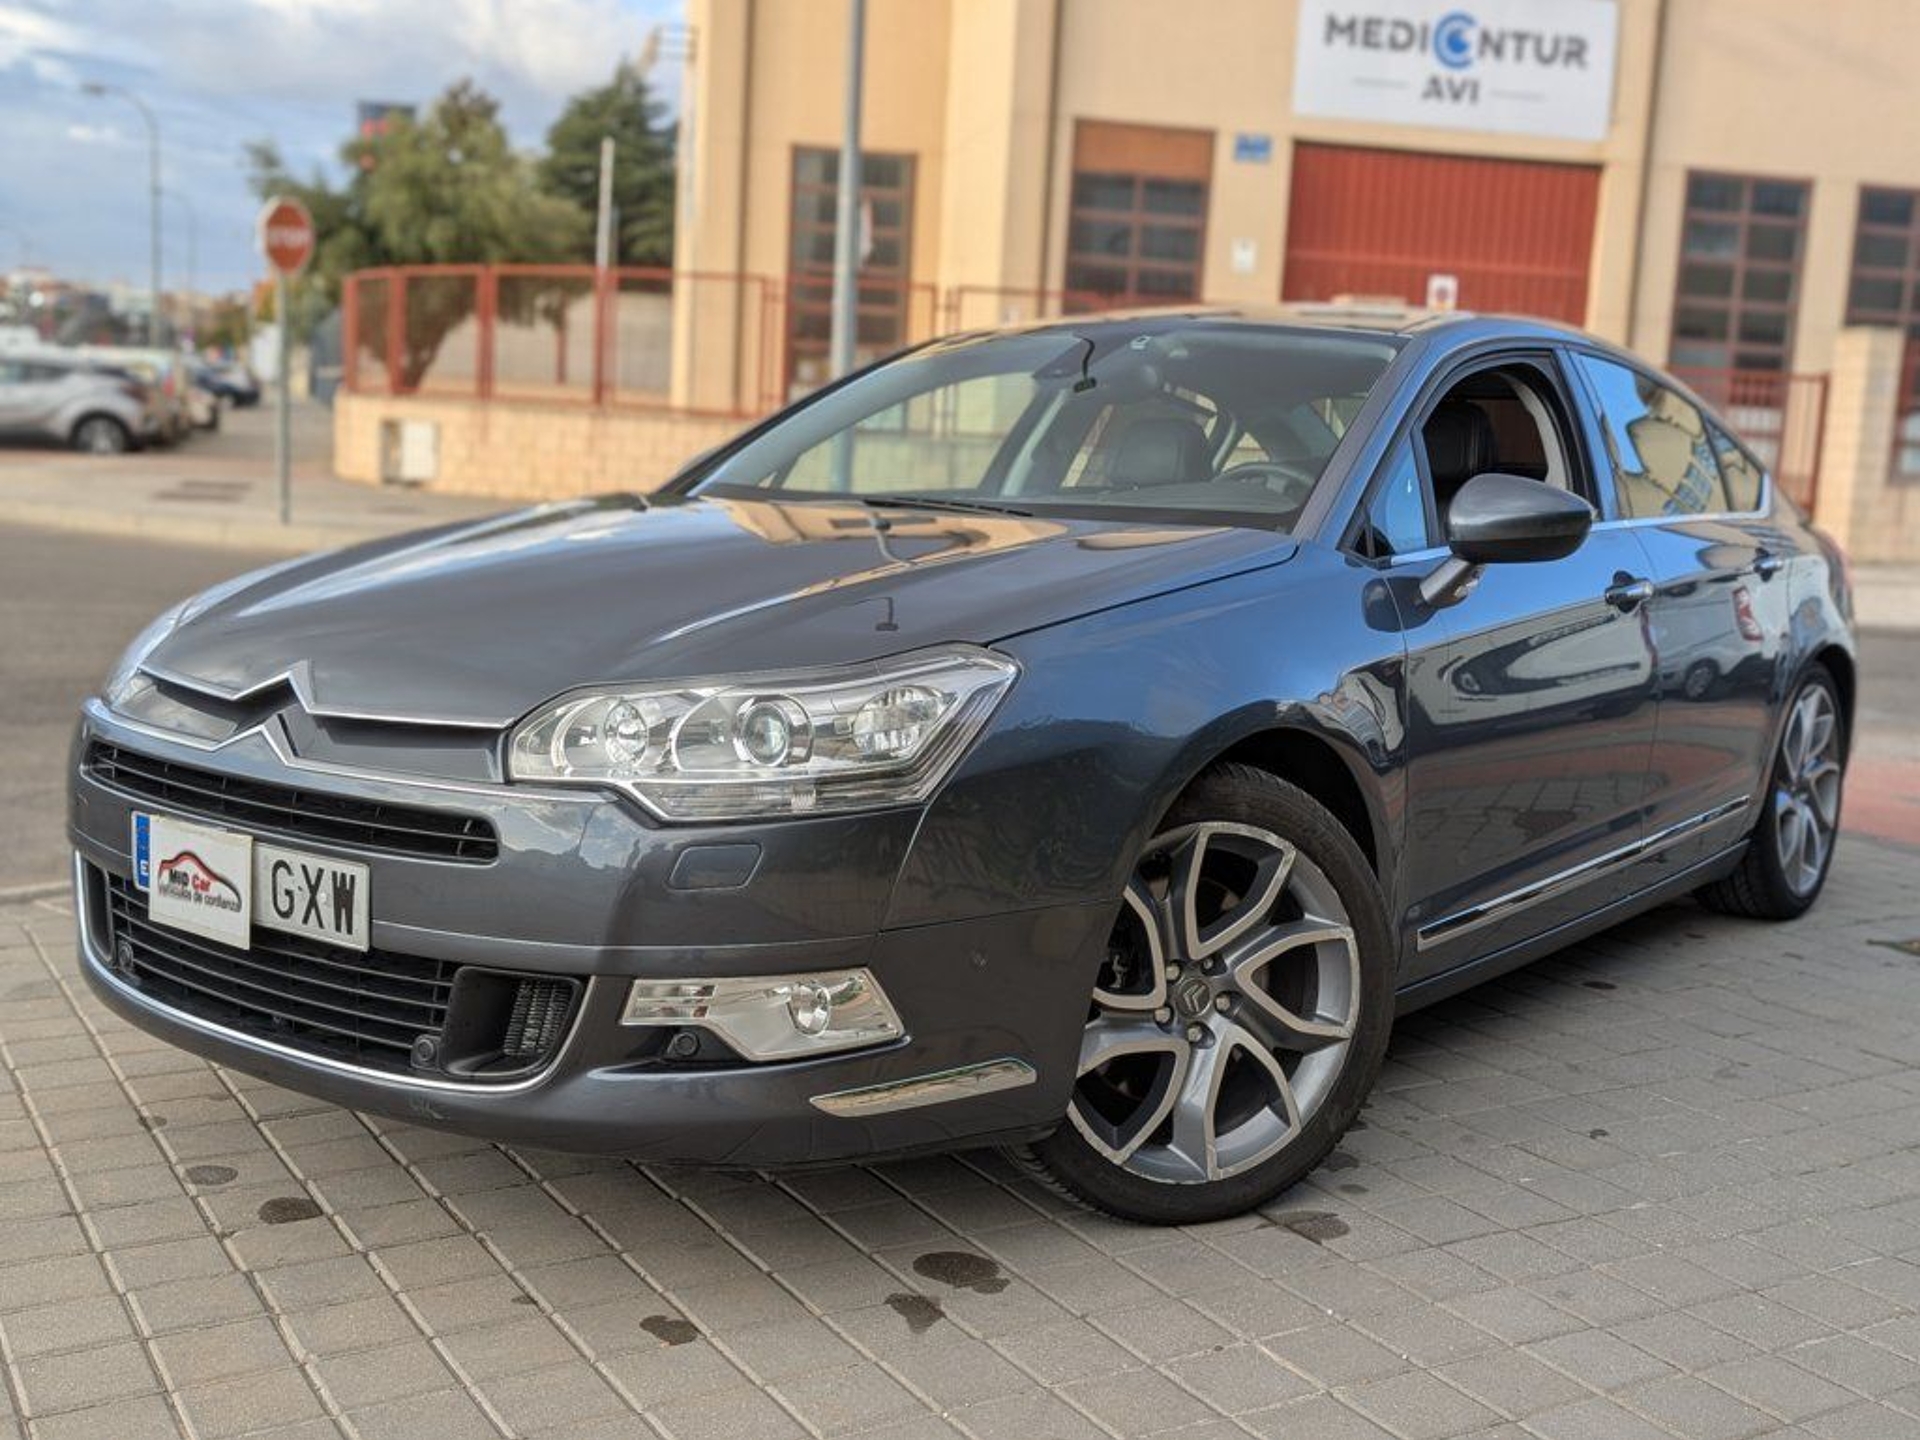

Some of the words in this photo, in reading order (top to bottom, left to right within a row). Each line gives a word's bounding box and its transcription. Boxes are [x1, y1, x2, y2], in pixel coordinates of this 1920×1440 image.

[1422, 76, 1480, 105] AVI
[141, 860, 149, 876] E
[271, 859, 355, 935] GXW
